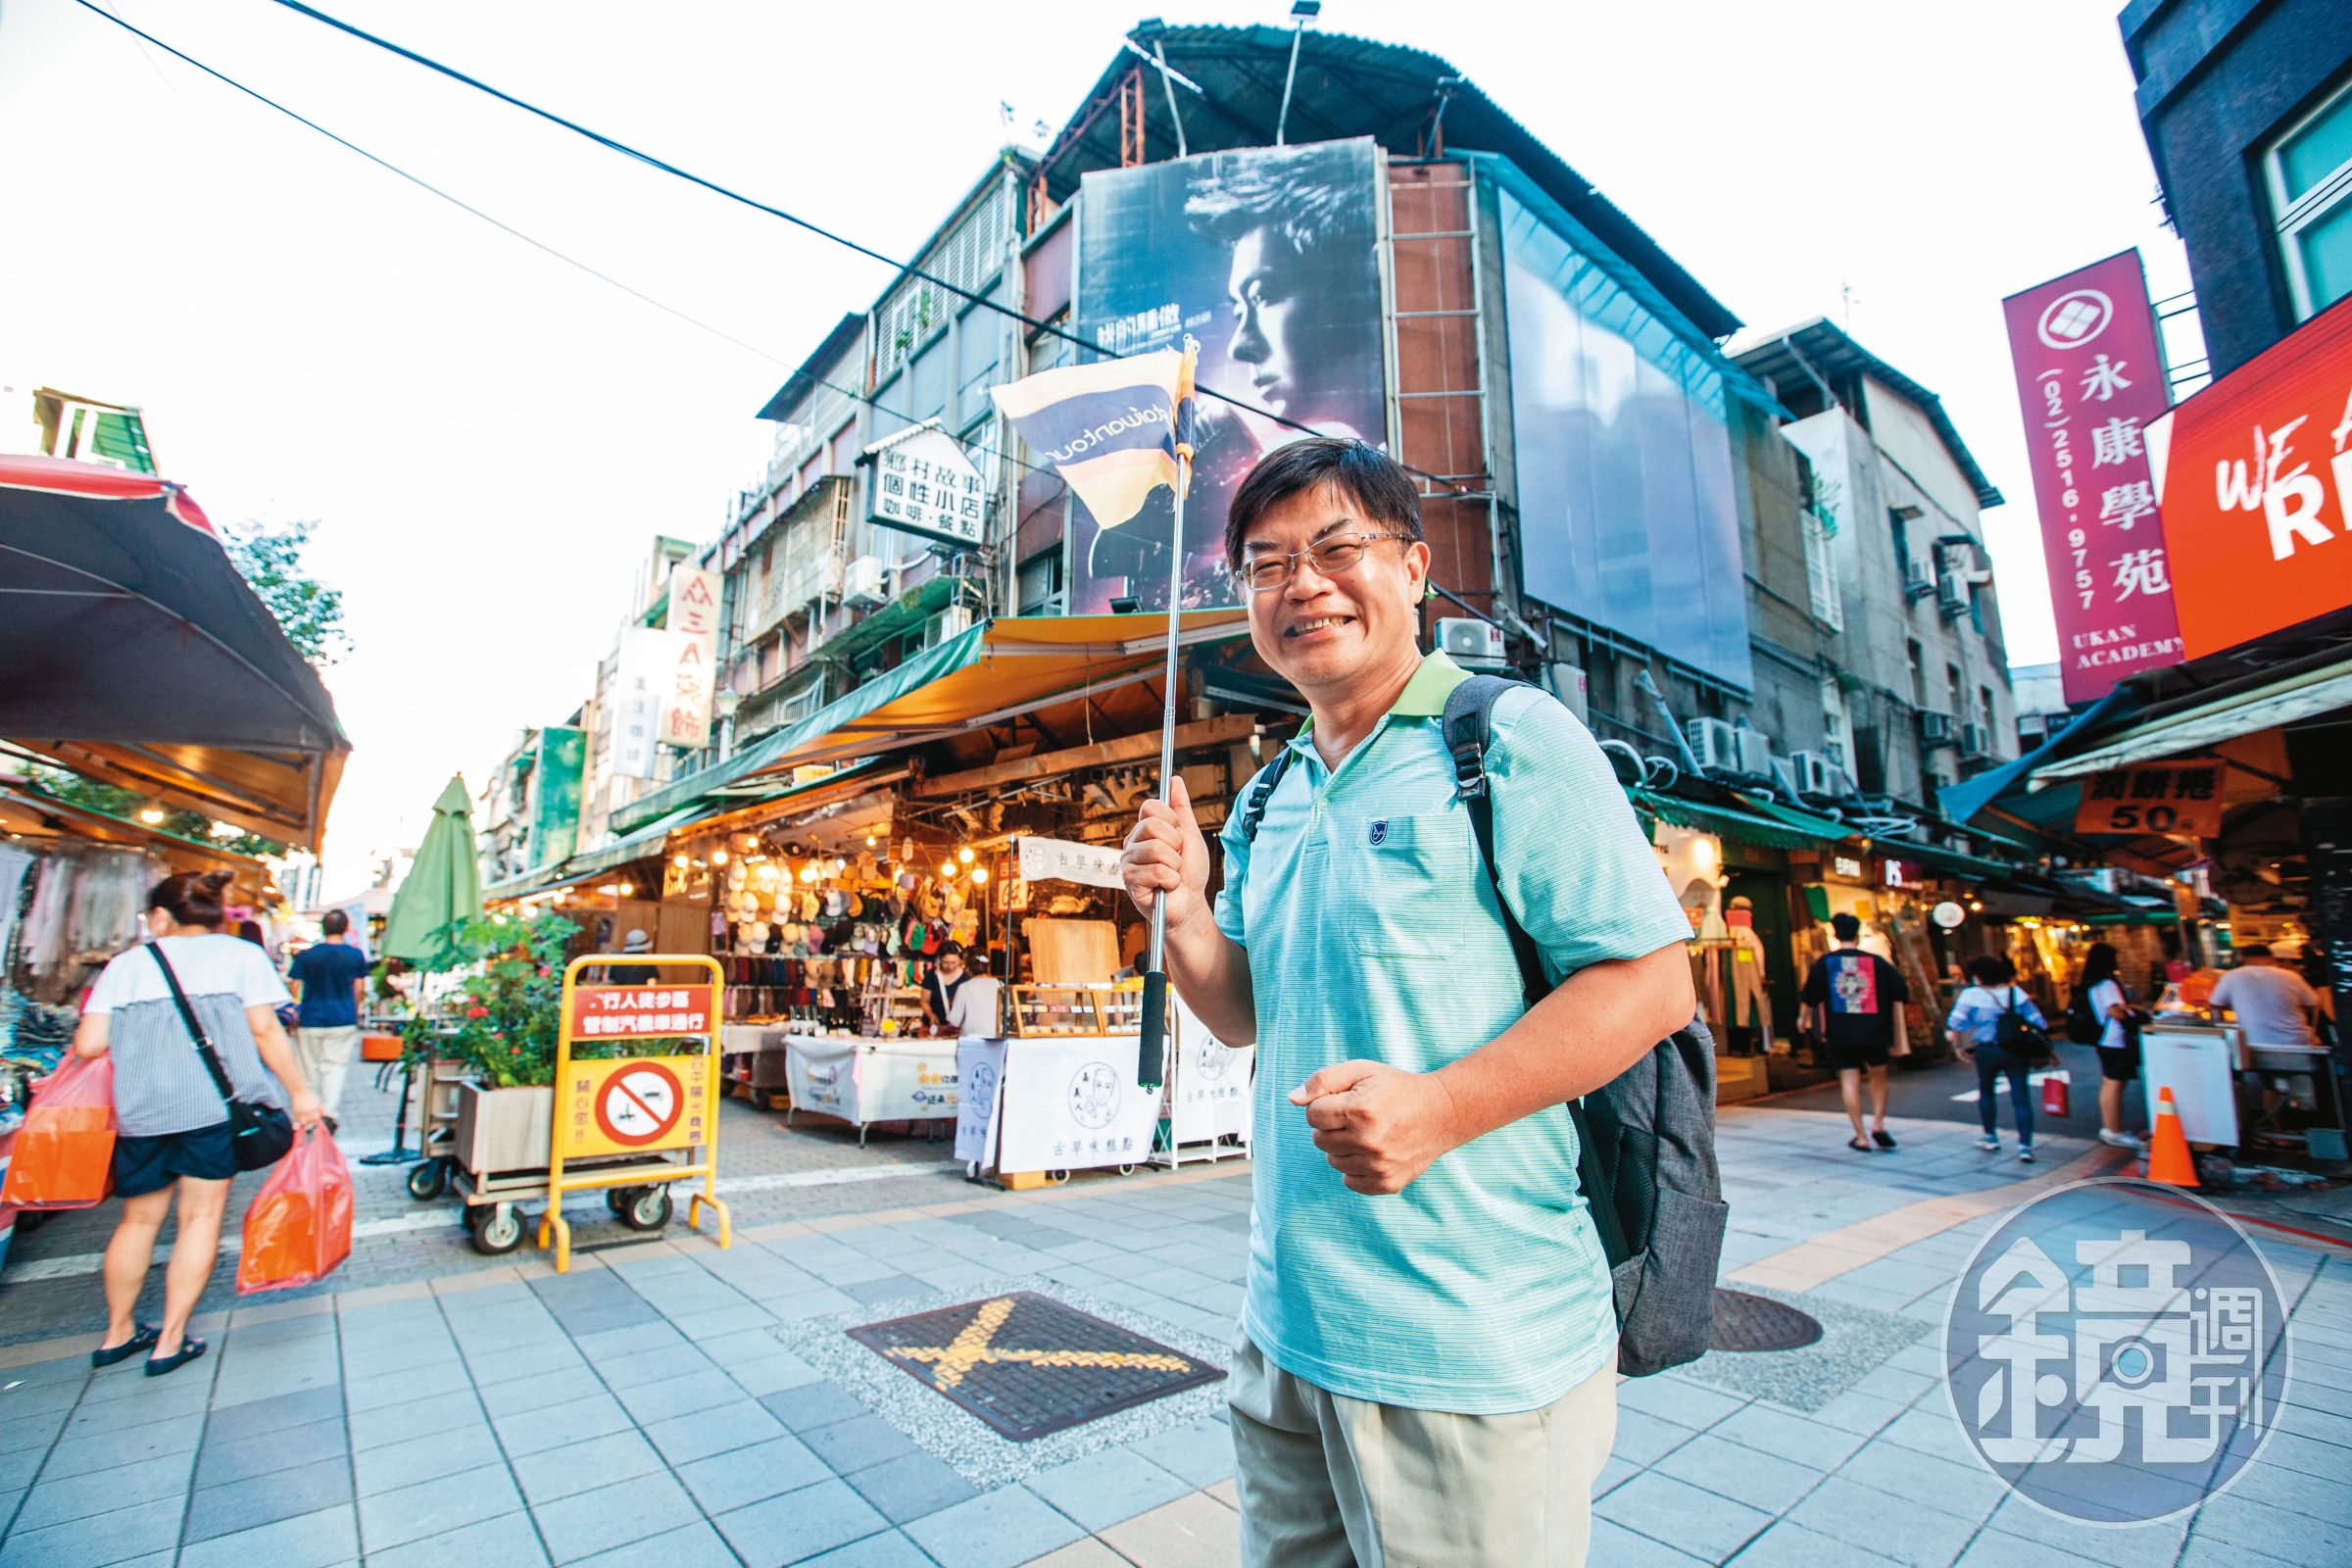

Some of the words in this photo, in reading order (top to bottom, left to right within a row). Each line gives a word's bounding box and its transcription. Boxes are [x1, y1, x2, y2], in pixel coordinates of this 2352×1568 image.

[884, 449, 980, 494] 鄉村故事
[2080, 354, 2172, 603] 永康學苑
[2216, 414, 2310, 512] WE
[884, 472, 979, 518] 個性小店
[2072, 623, 2137, 649] UKAN
[2076, 636, 2183, 669] ACADEMY
[602, 990, 690, 1010] 行人徒步區
[582, 1012, 706, 1035] 管制汽機車通行
